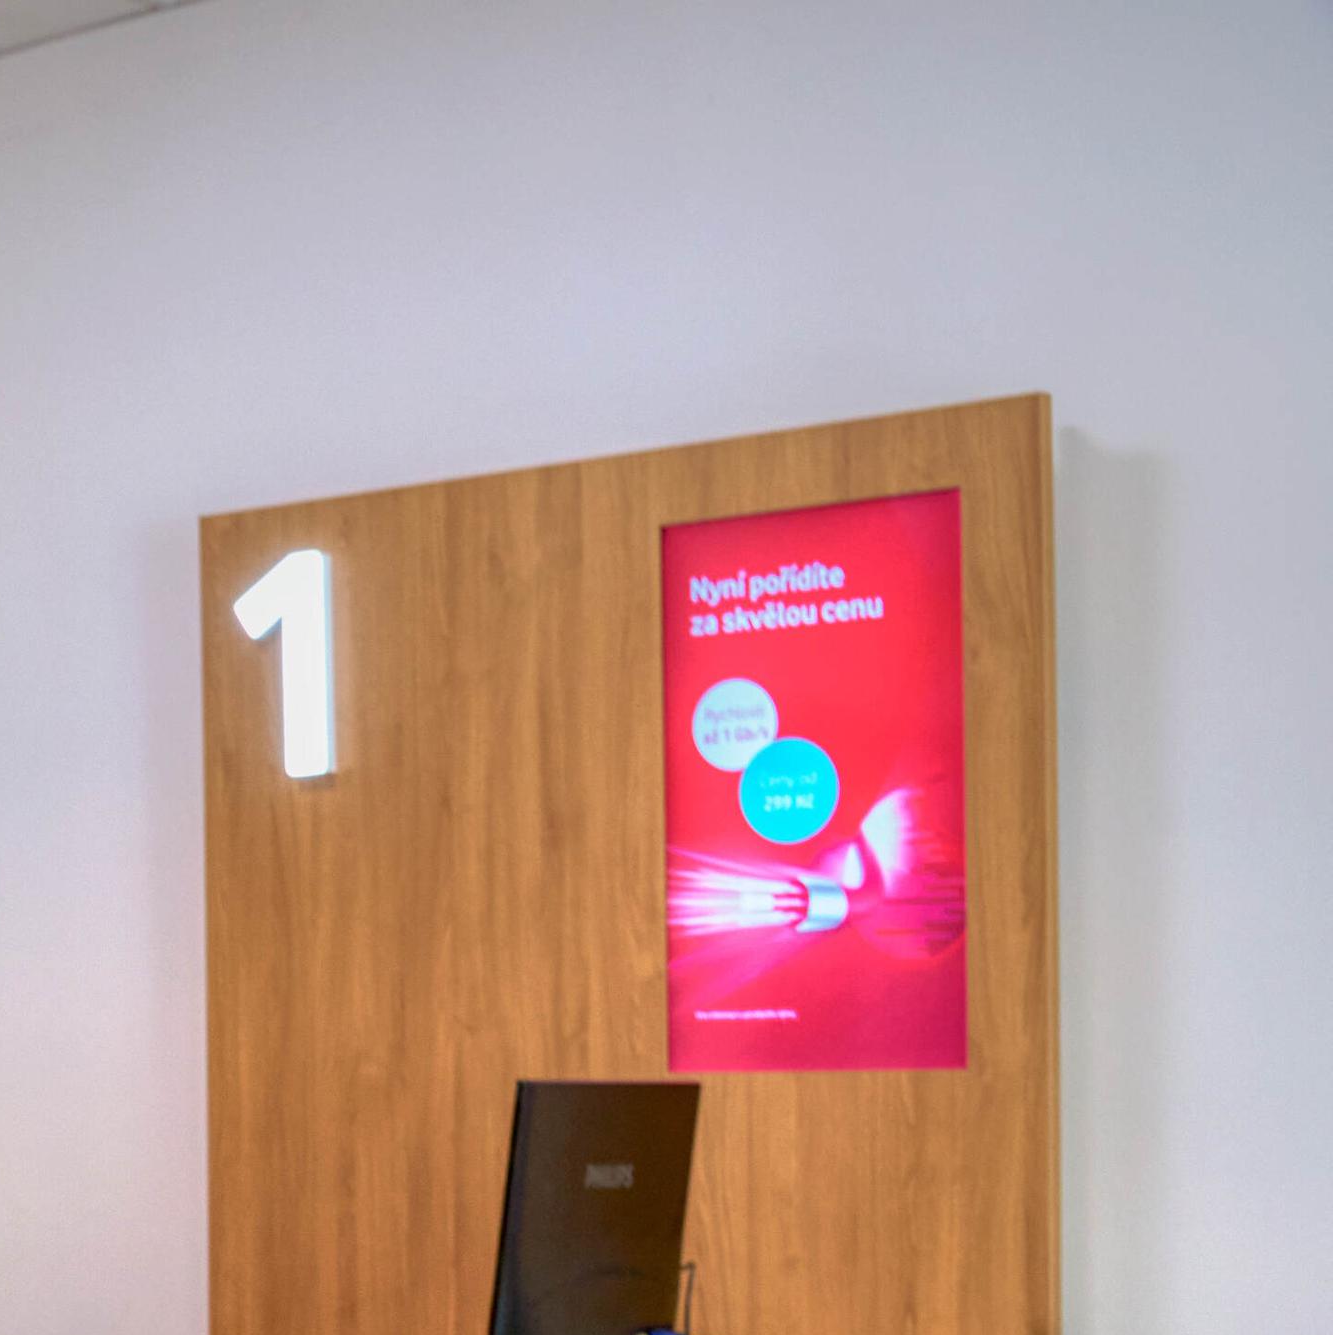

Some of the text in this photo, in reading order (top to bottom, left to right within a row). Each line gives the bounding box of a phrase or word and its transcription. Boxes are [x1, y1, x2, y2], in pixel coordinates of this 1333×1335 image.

[690, 569, 746, 607] Nyní
[690, 596, 884, 637] za skvělou cenu
[233, 549, 333, 779] 1
